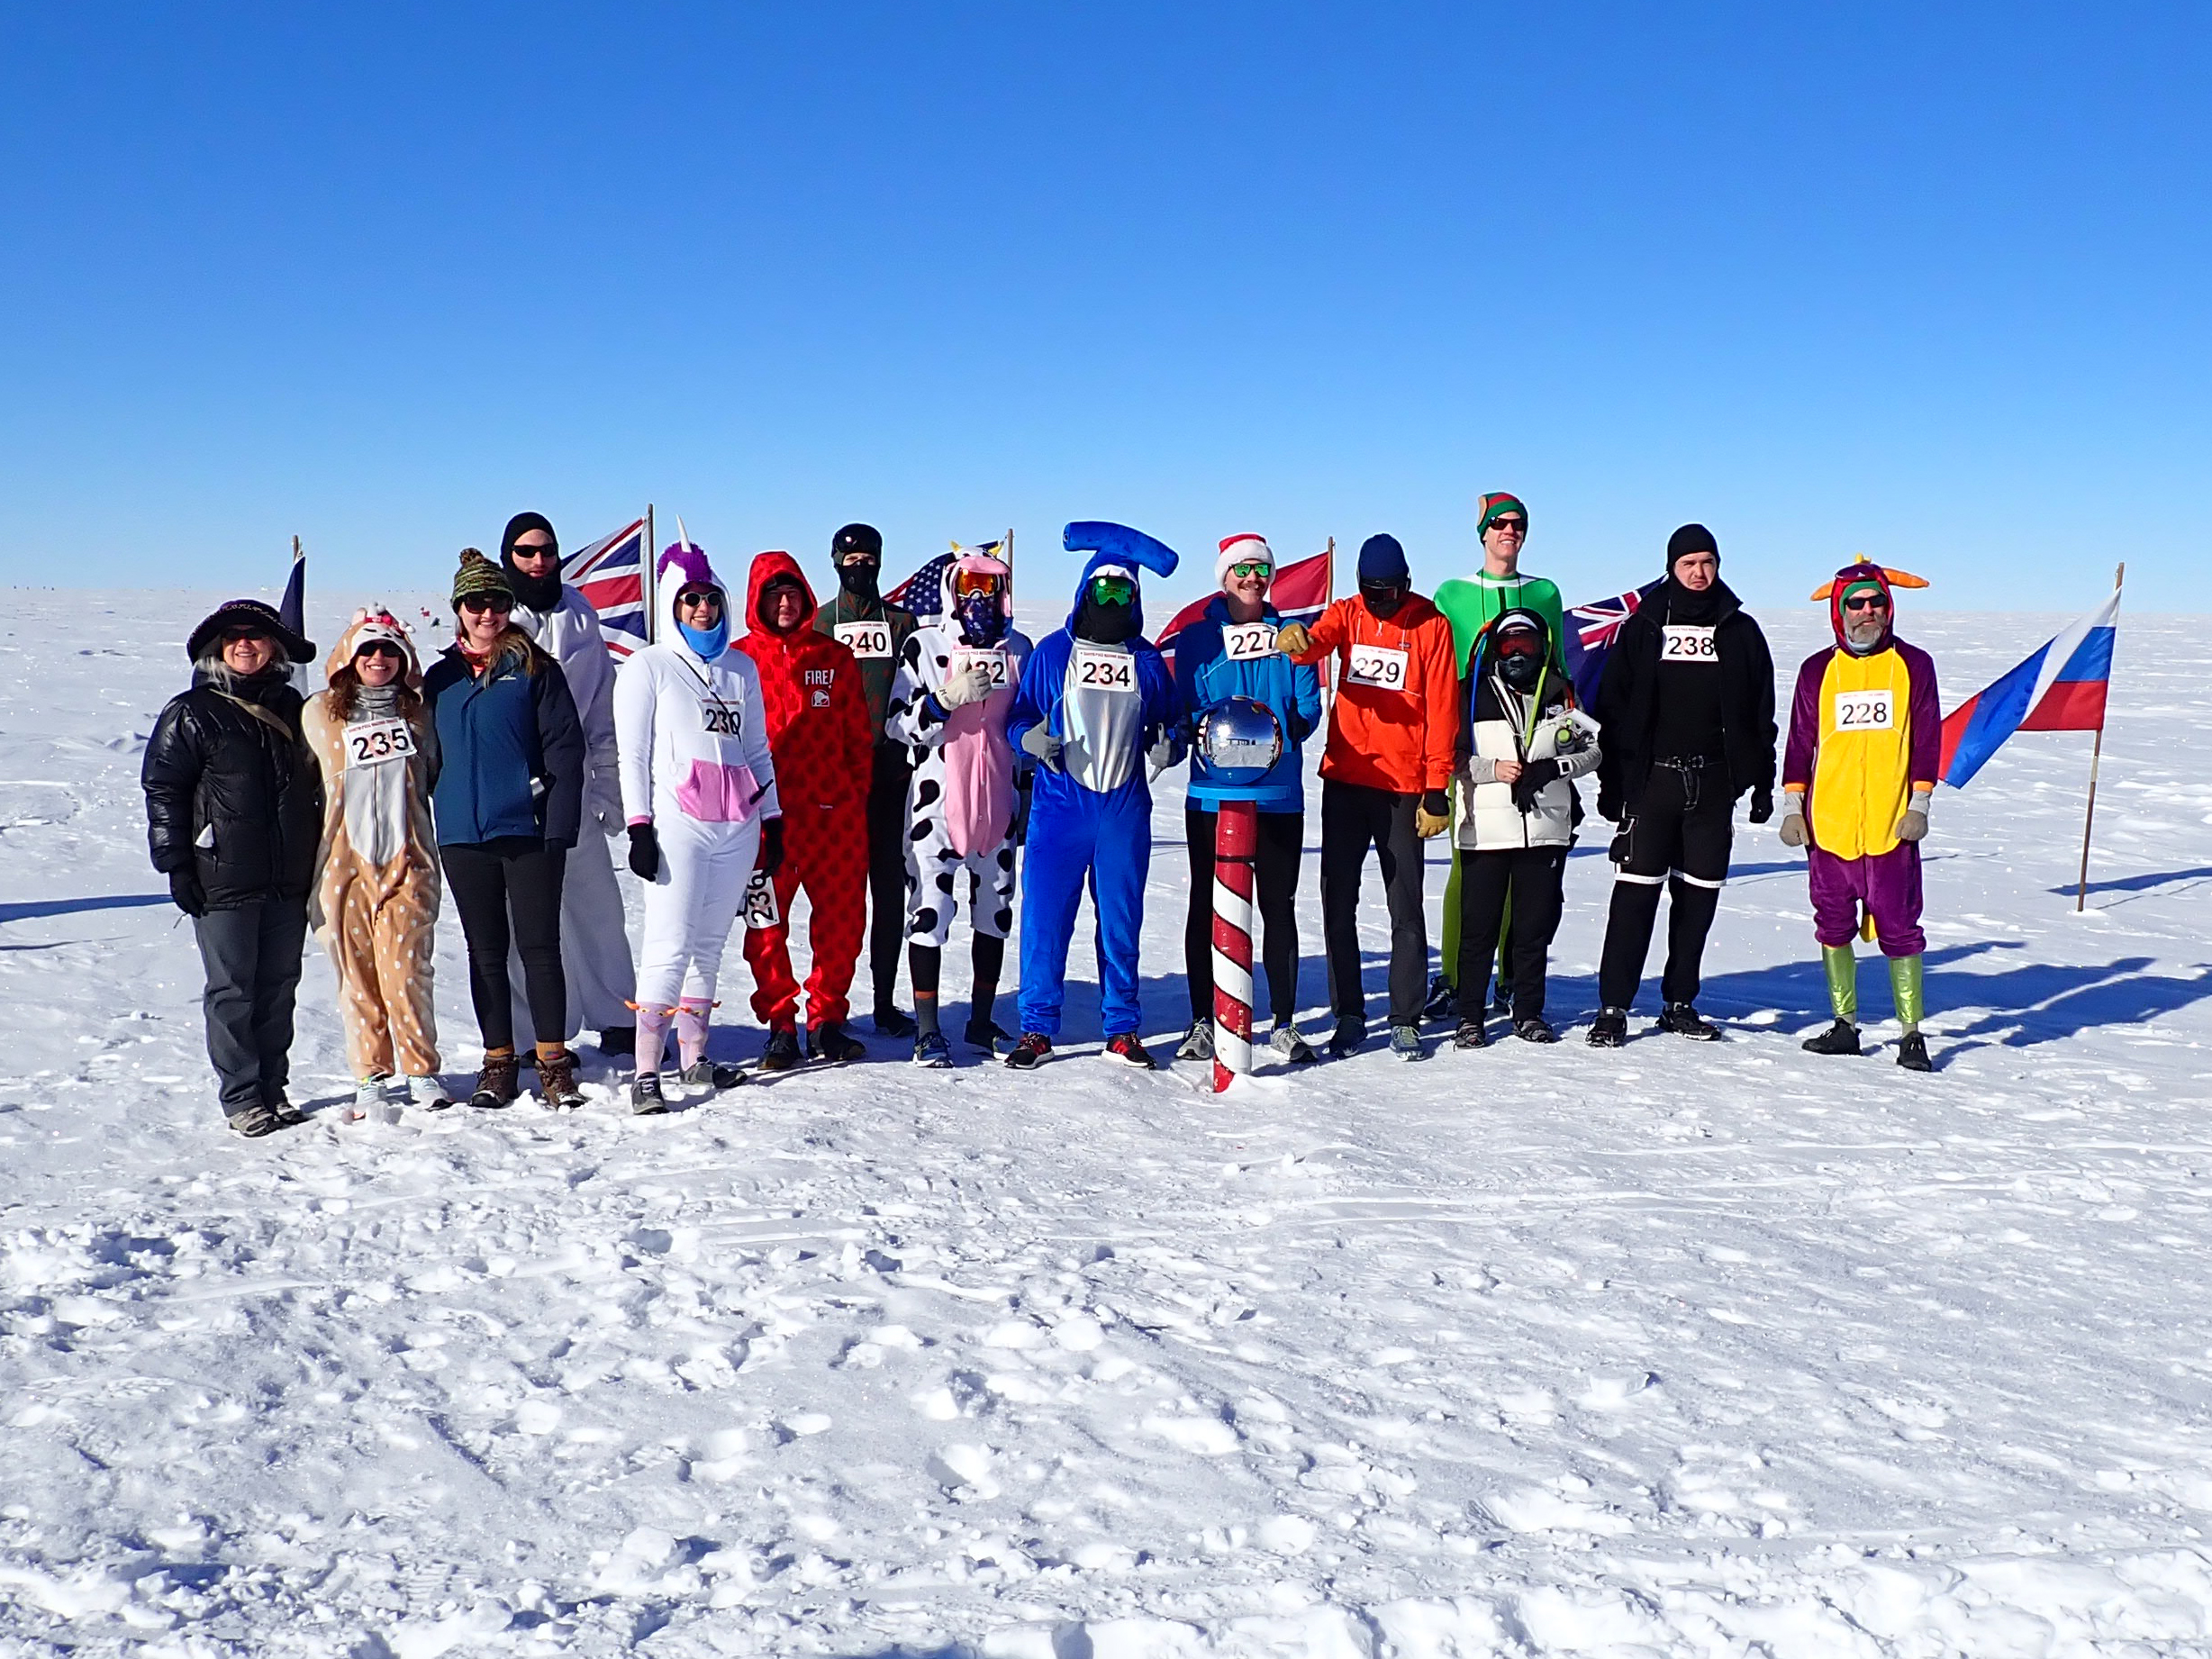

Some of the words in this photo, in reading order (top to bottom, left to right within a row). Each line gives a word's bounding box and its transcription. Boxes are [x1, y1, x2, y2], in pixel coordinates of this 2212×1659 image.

[841, 631, 886, 652] 240
[1230, 630, 1275, 655] 227
[1668, 636, 1714, 656] 238
[805, 668, 835, 689] FIRE!
[1082, 662, 1130, 686] 234
[1352, 657, 1400, 683] 229
[1842, 703, 1886, 725] 228
[352, 728, 409, 760] 235
[747, 874, 775, 923] 236
